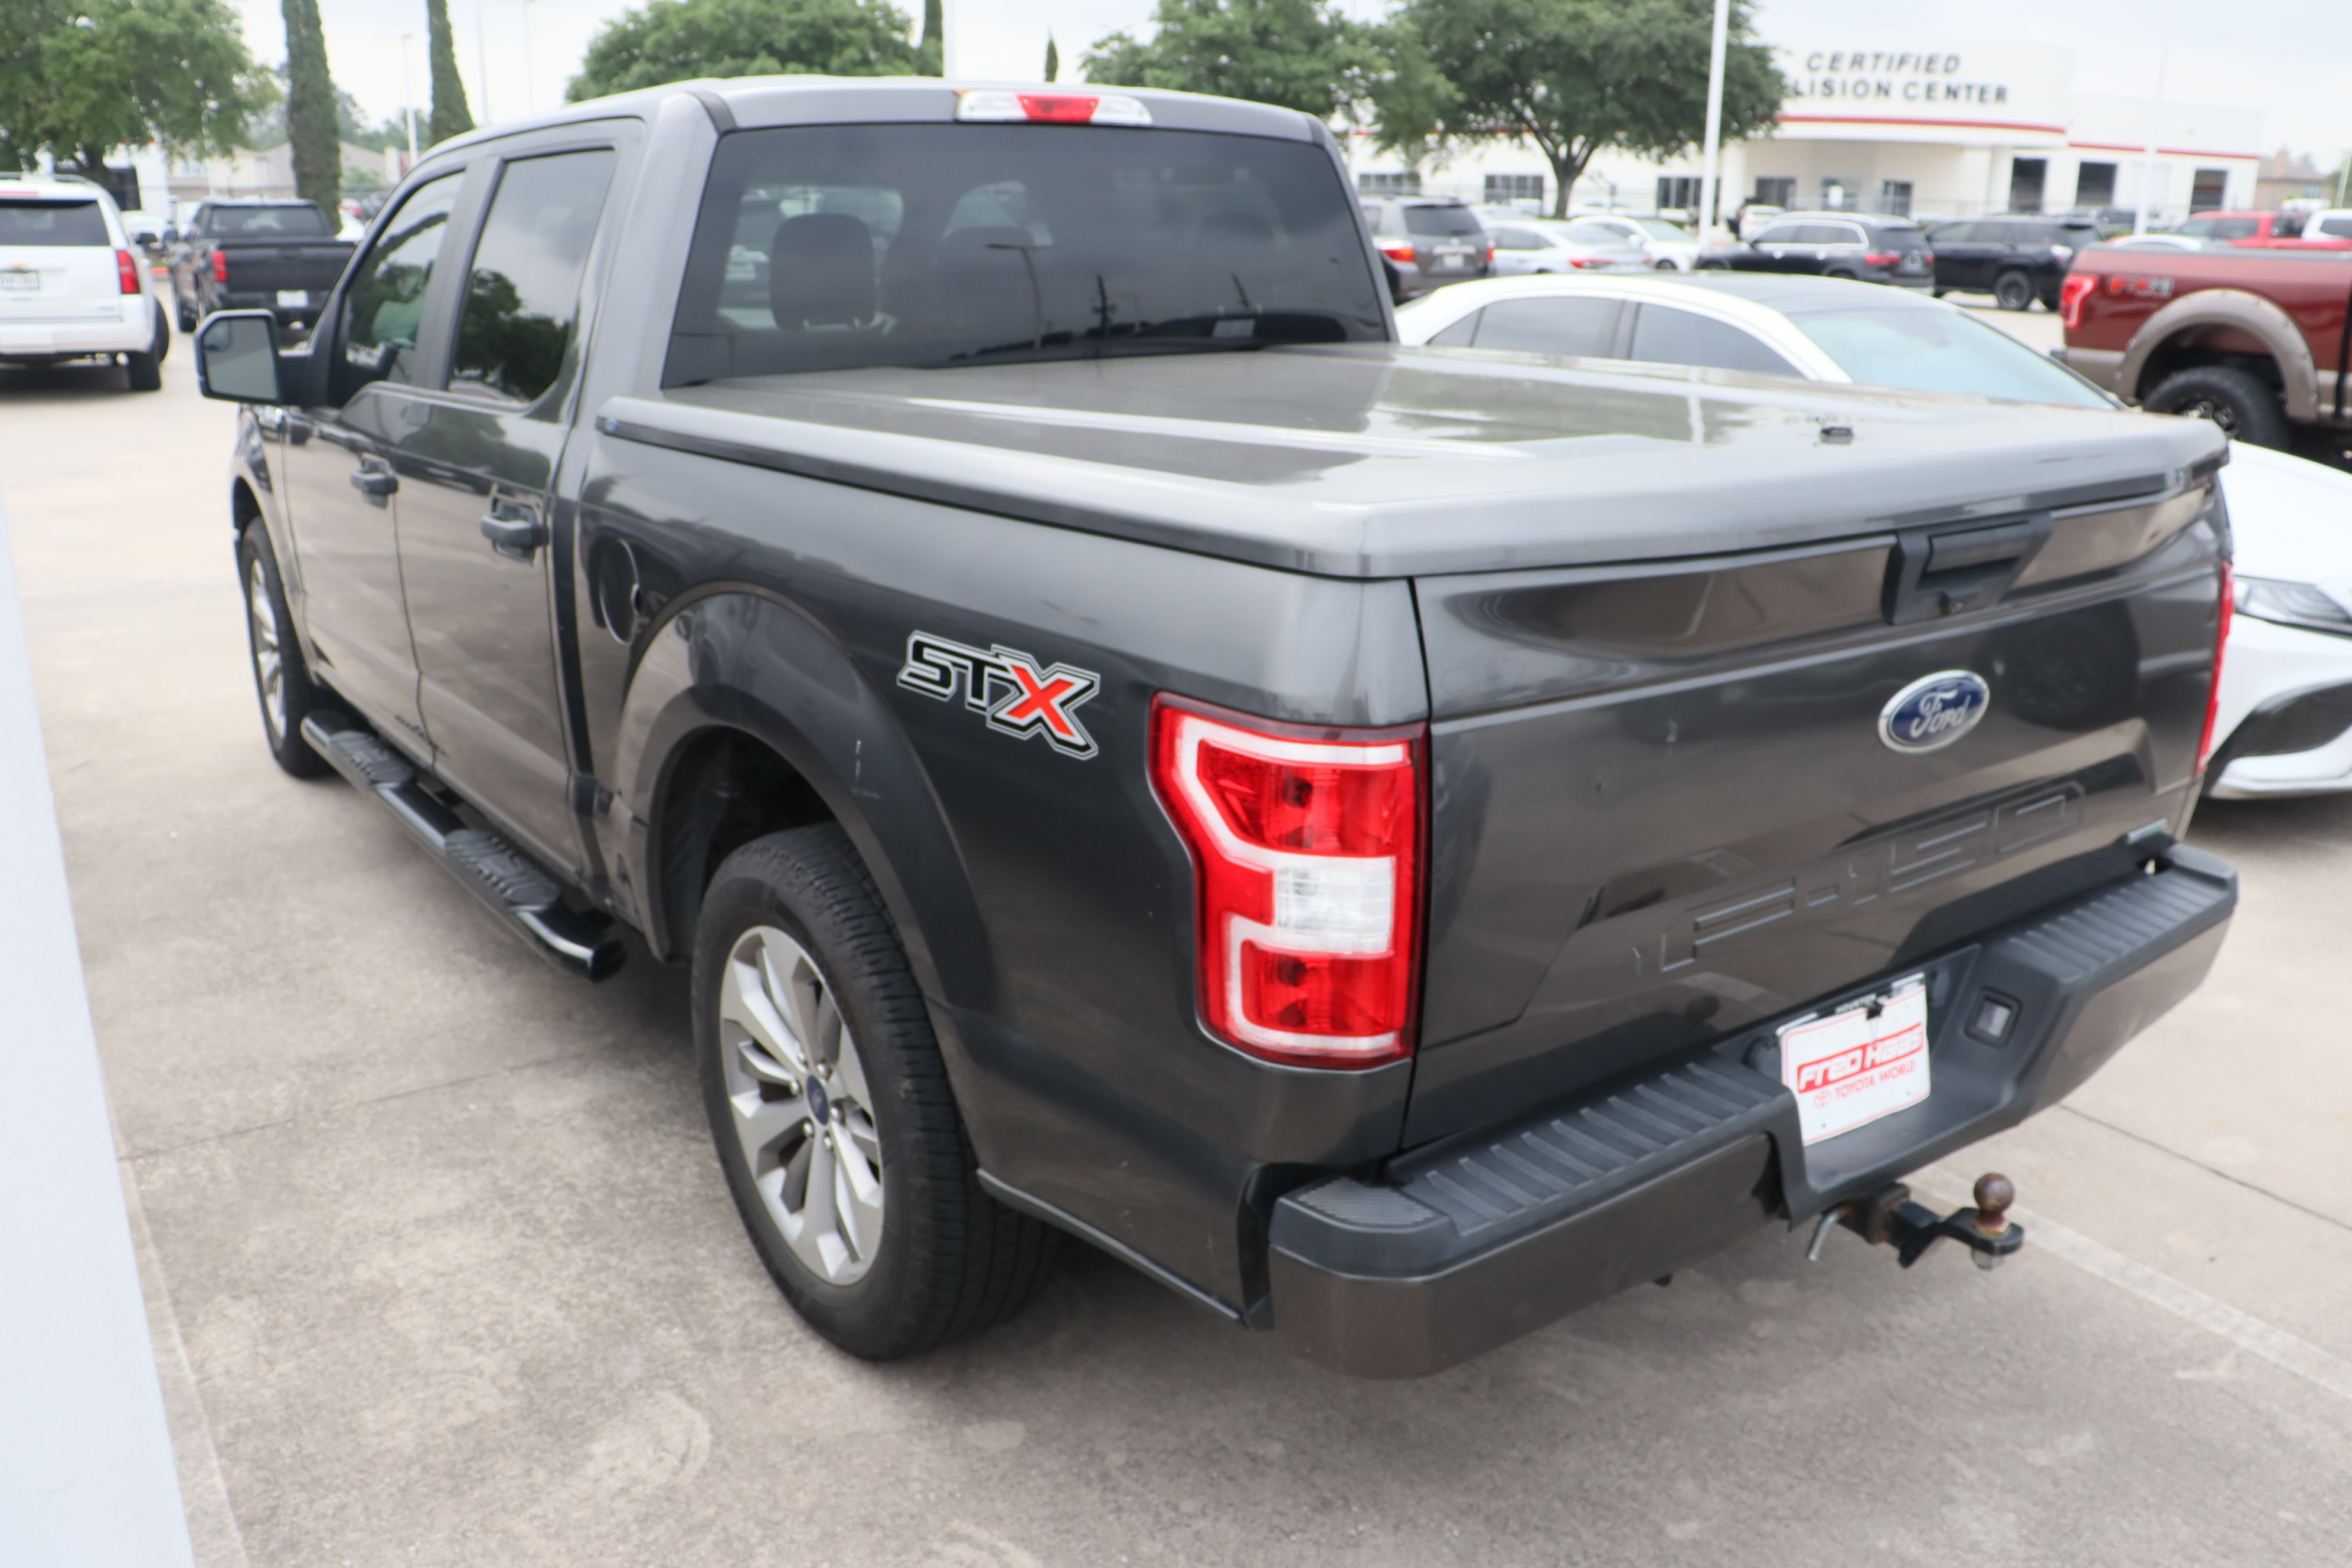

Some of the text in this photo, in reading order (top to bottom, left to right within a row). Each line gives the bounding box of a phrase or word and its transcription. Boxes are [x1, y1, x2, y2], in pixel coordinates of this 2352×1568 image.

[1807, 51, 1961, 73] CERTIFIED
[1792, 78, 2008, 102] LISION CENTER
[896, 629, 1101, 762] STX
[1909, 689, 1972, 739] Ford
[1835, 1059, 1917, 1099] TOYOTA WORLD
